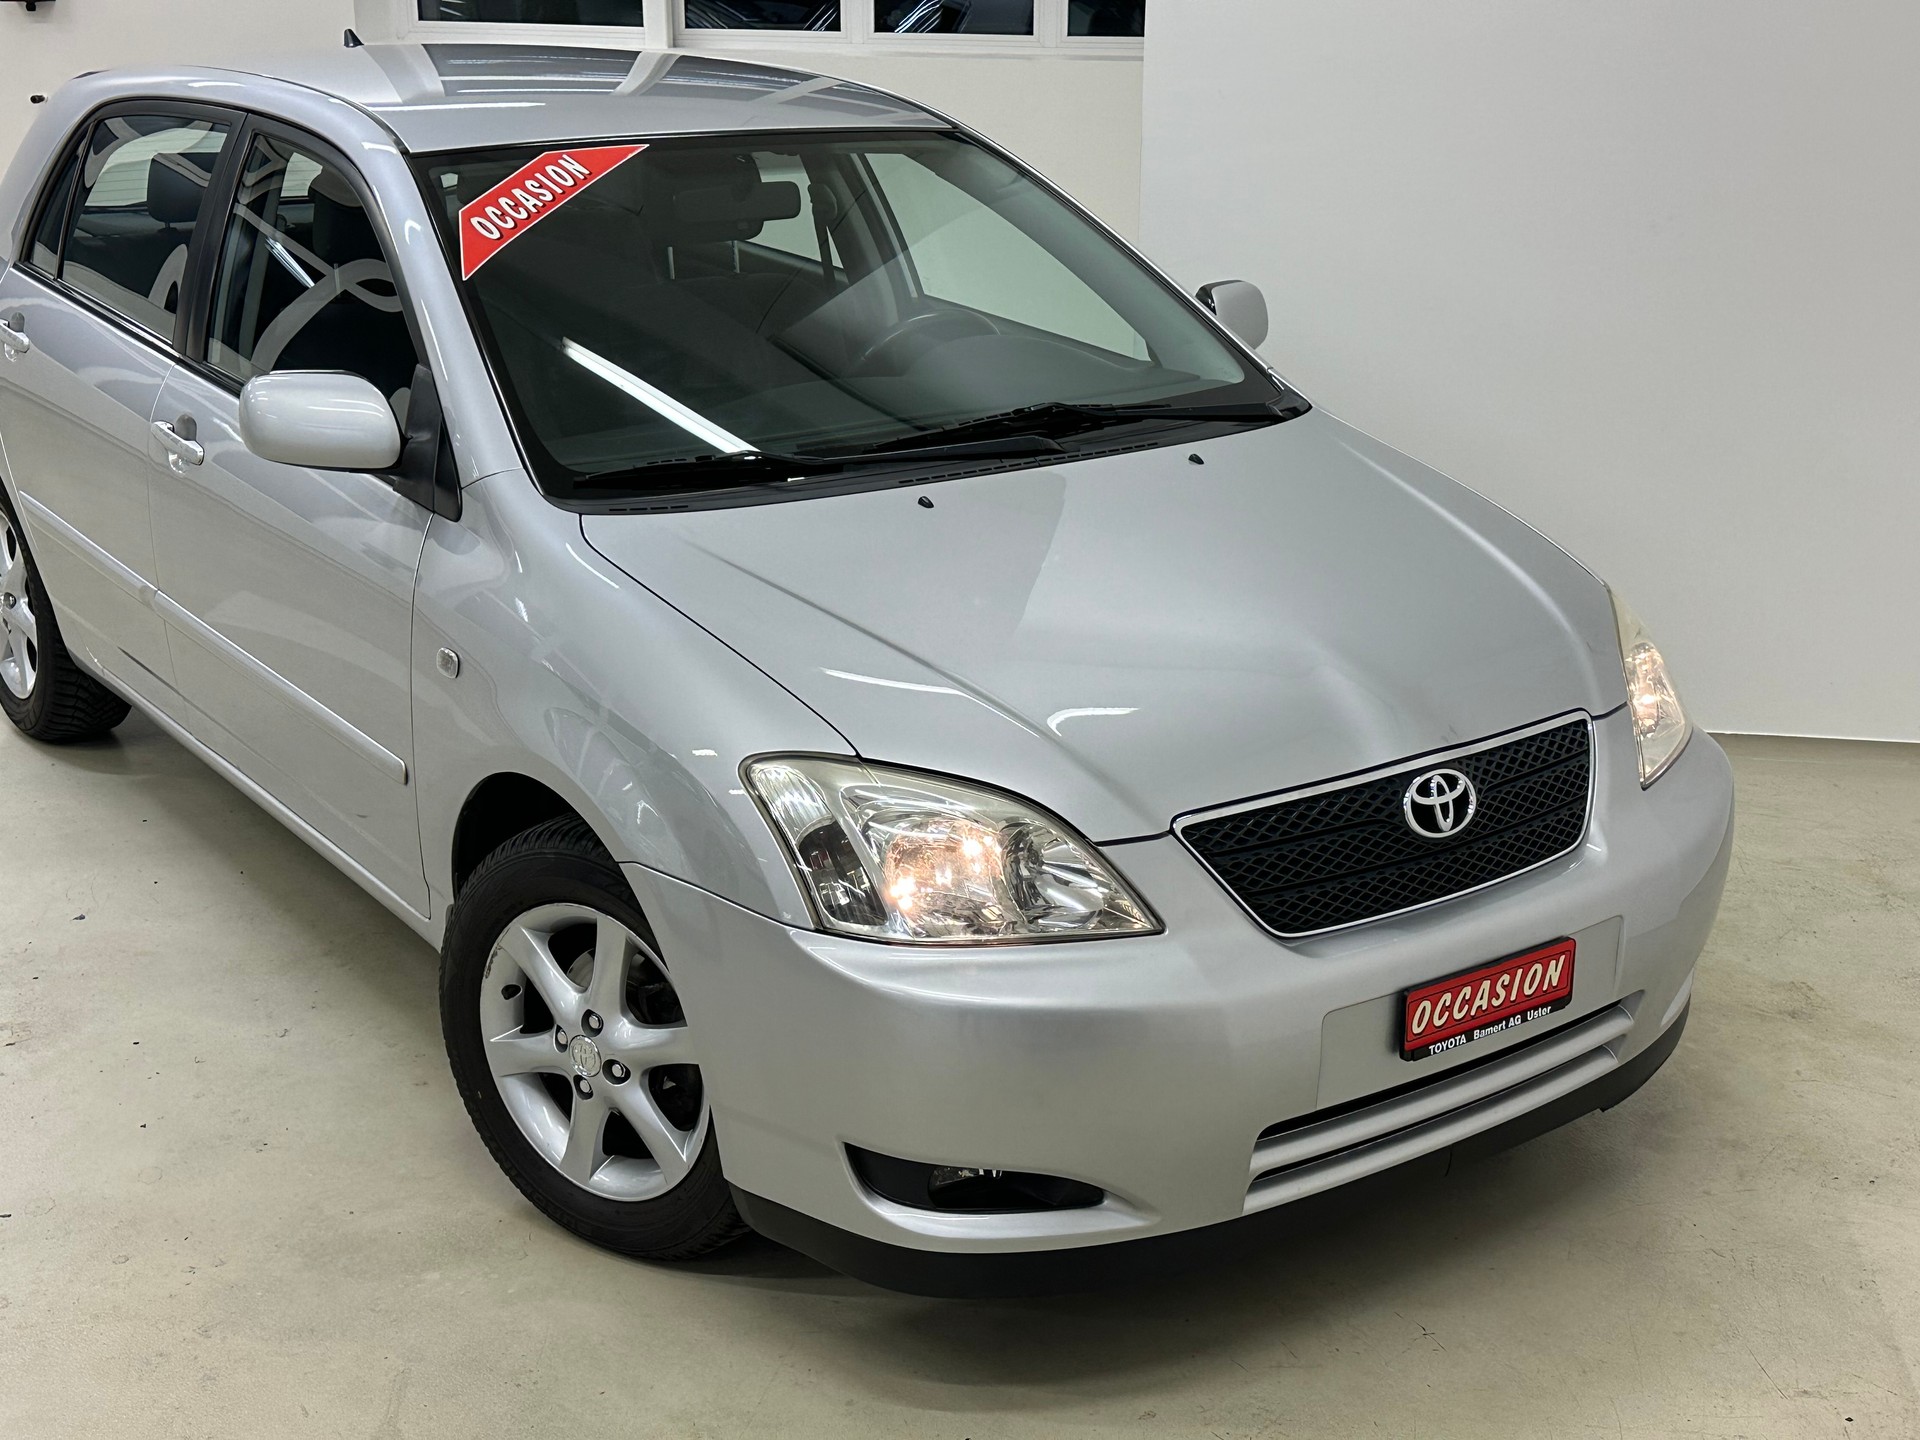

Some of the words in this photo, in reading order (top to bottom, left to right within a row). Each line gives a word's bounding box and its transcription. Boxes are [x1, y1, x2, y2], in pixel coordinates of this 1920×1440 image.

[470, 154, 592, 240] OCCASION
[1411, 954, 1566, 1034] OCCASION
[1428, 1035, 1467, 1056] TOYOTA
[1473, 1020, 1507, 1041] Bamert
[1508, 1015, 1522, 1028] AG
[1527, 1006, 1552, 1021] Uster
